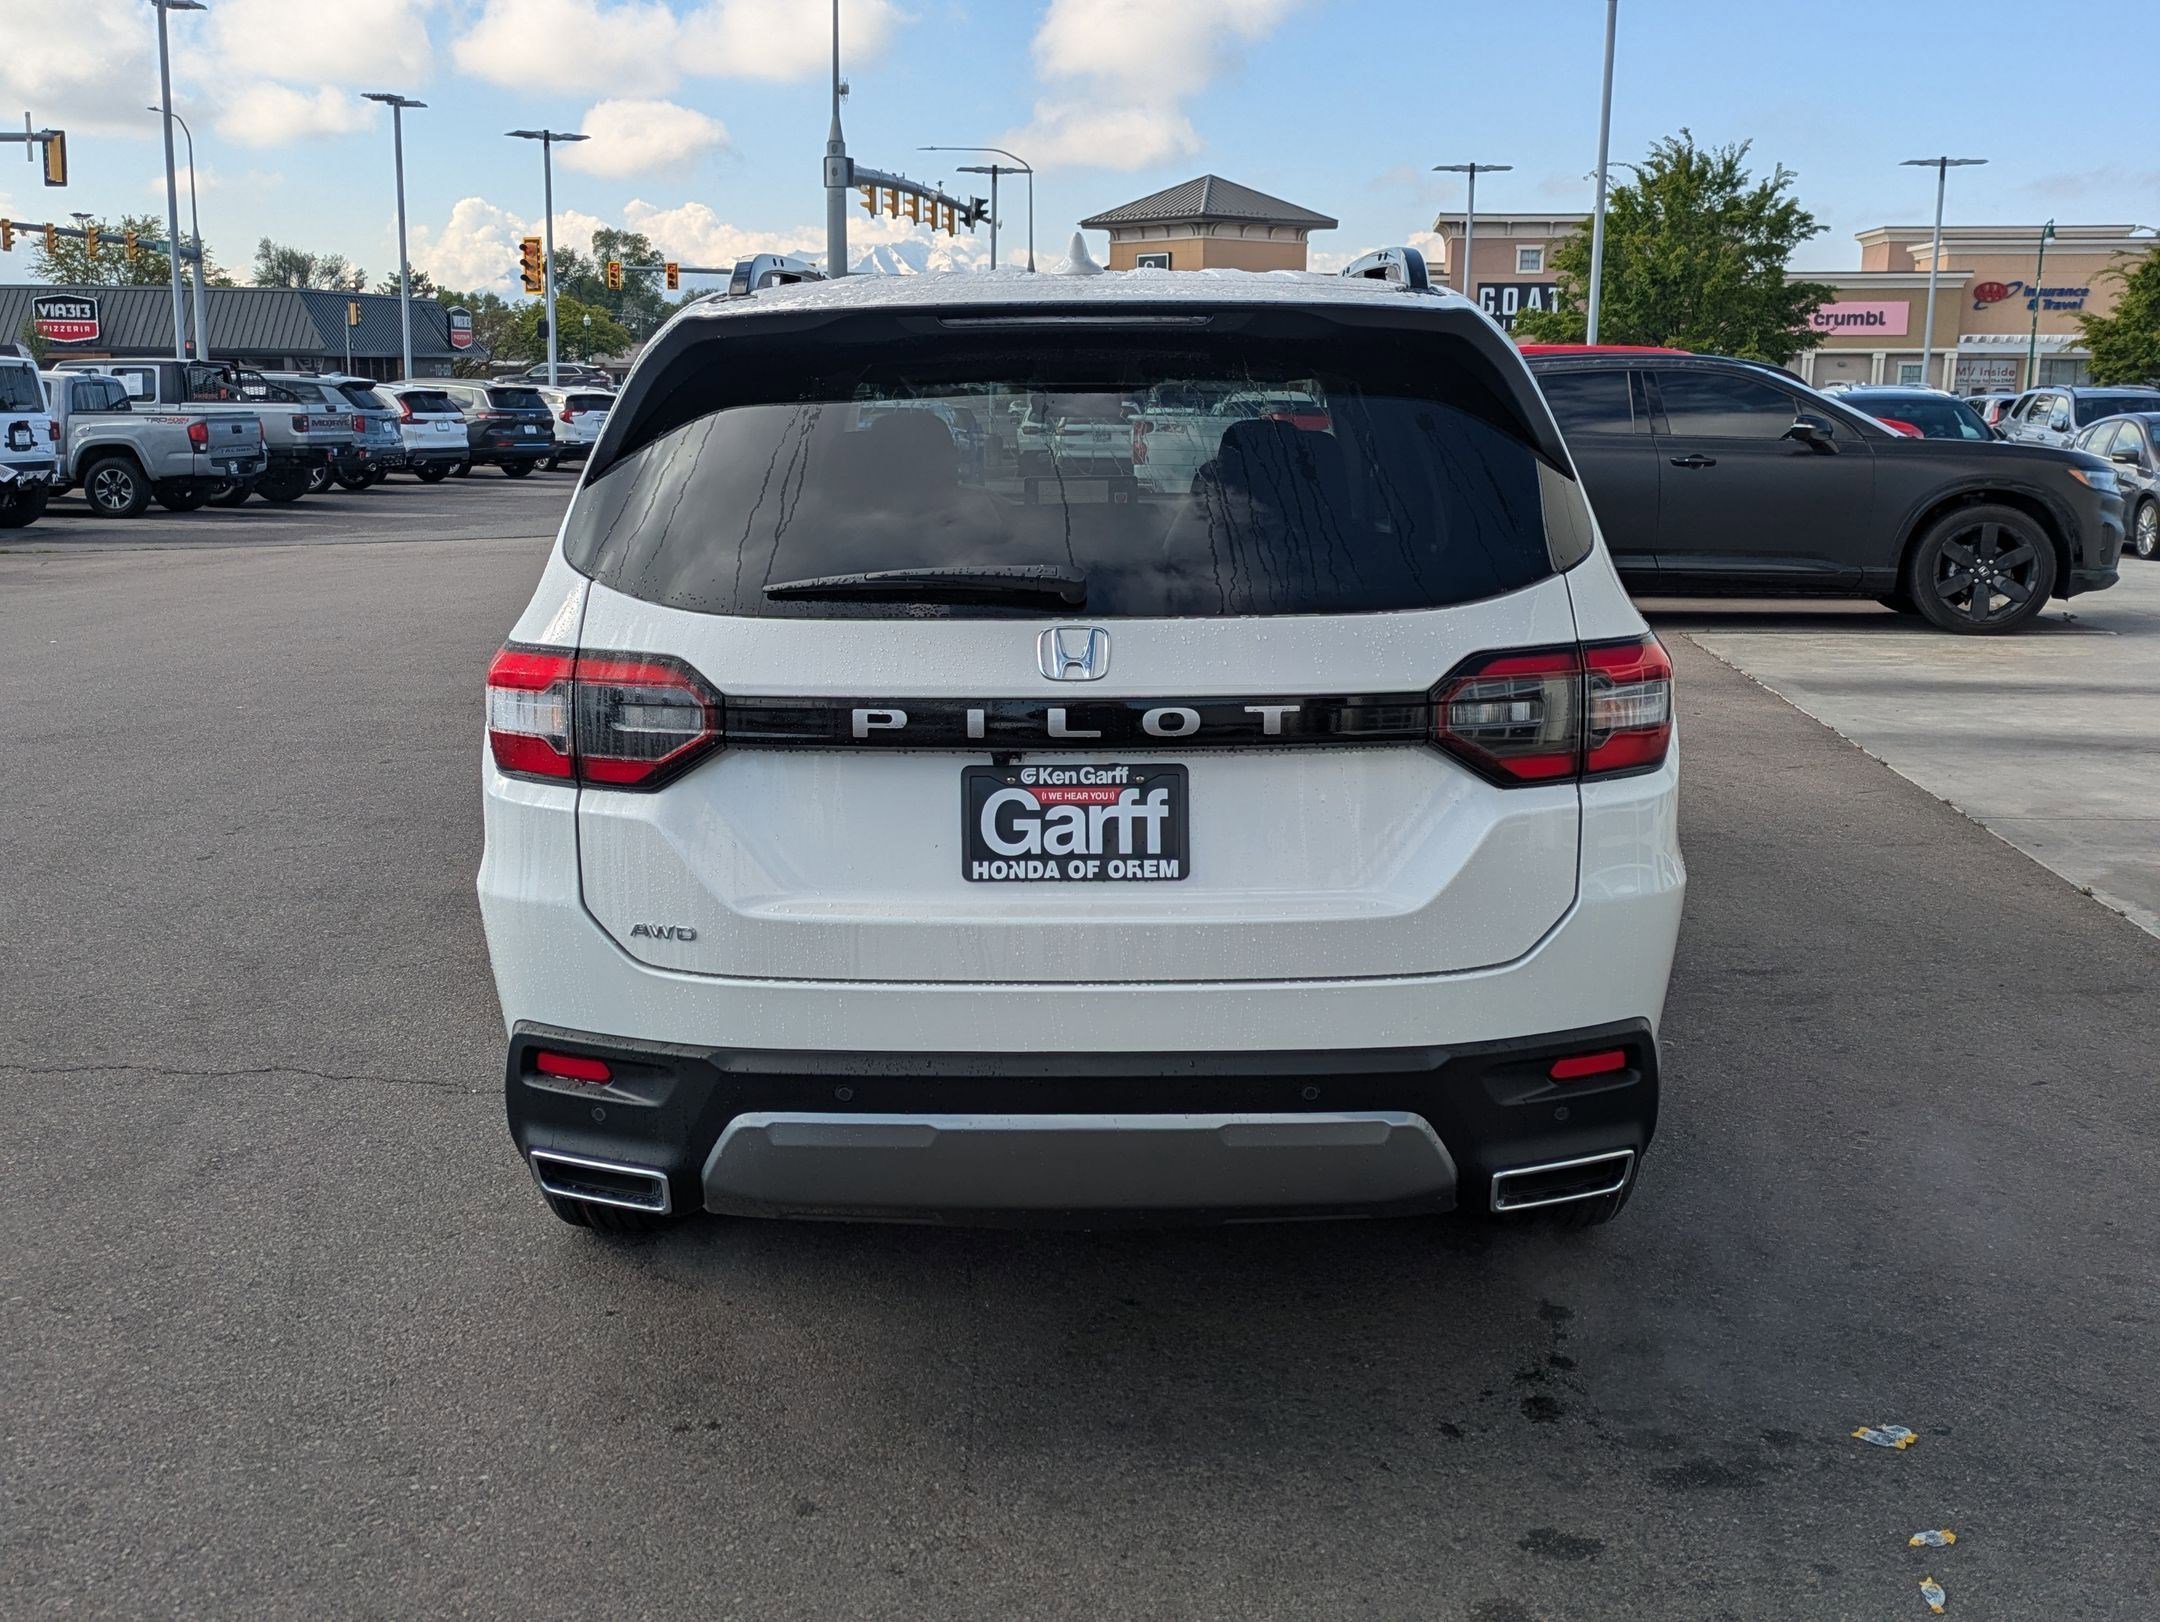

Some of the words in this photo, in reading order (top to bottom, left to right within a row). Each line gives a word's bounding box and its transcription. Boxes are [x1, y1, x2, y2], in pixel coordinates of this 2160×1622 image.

[2023, 285, 2090, 297] Inurance
[2043, 298, 2084, 310] Travel
[1813, 310, 1886, 326] crumbl
[43, 325, 91, 333] PIZZERIA
[1980, 366, 2016, 377] Inside
[852, 705, 1300, 739] PILOT
[1038, 767, 1077, 785] Ken
[1079, 766, 1129, 784] Garff
[1049, 792, 1064, 801] WE
[1065, 792, 1090, 801] HEAR
[1090, 792, 1110, 801] YOU
[980, 787, 1169, 857] Garff
[972, 860, 1061, 880] HONDA
[1067, 860, 1101, 880] OF
[1107, 859, 1180, 879] OREM
[630, 922, 698, 942] AWD
